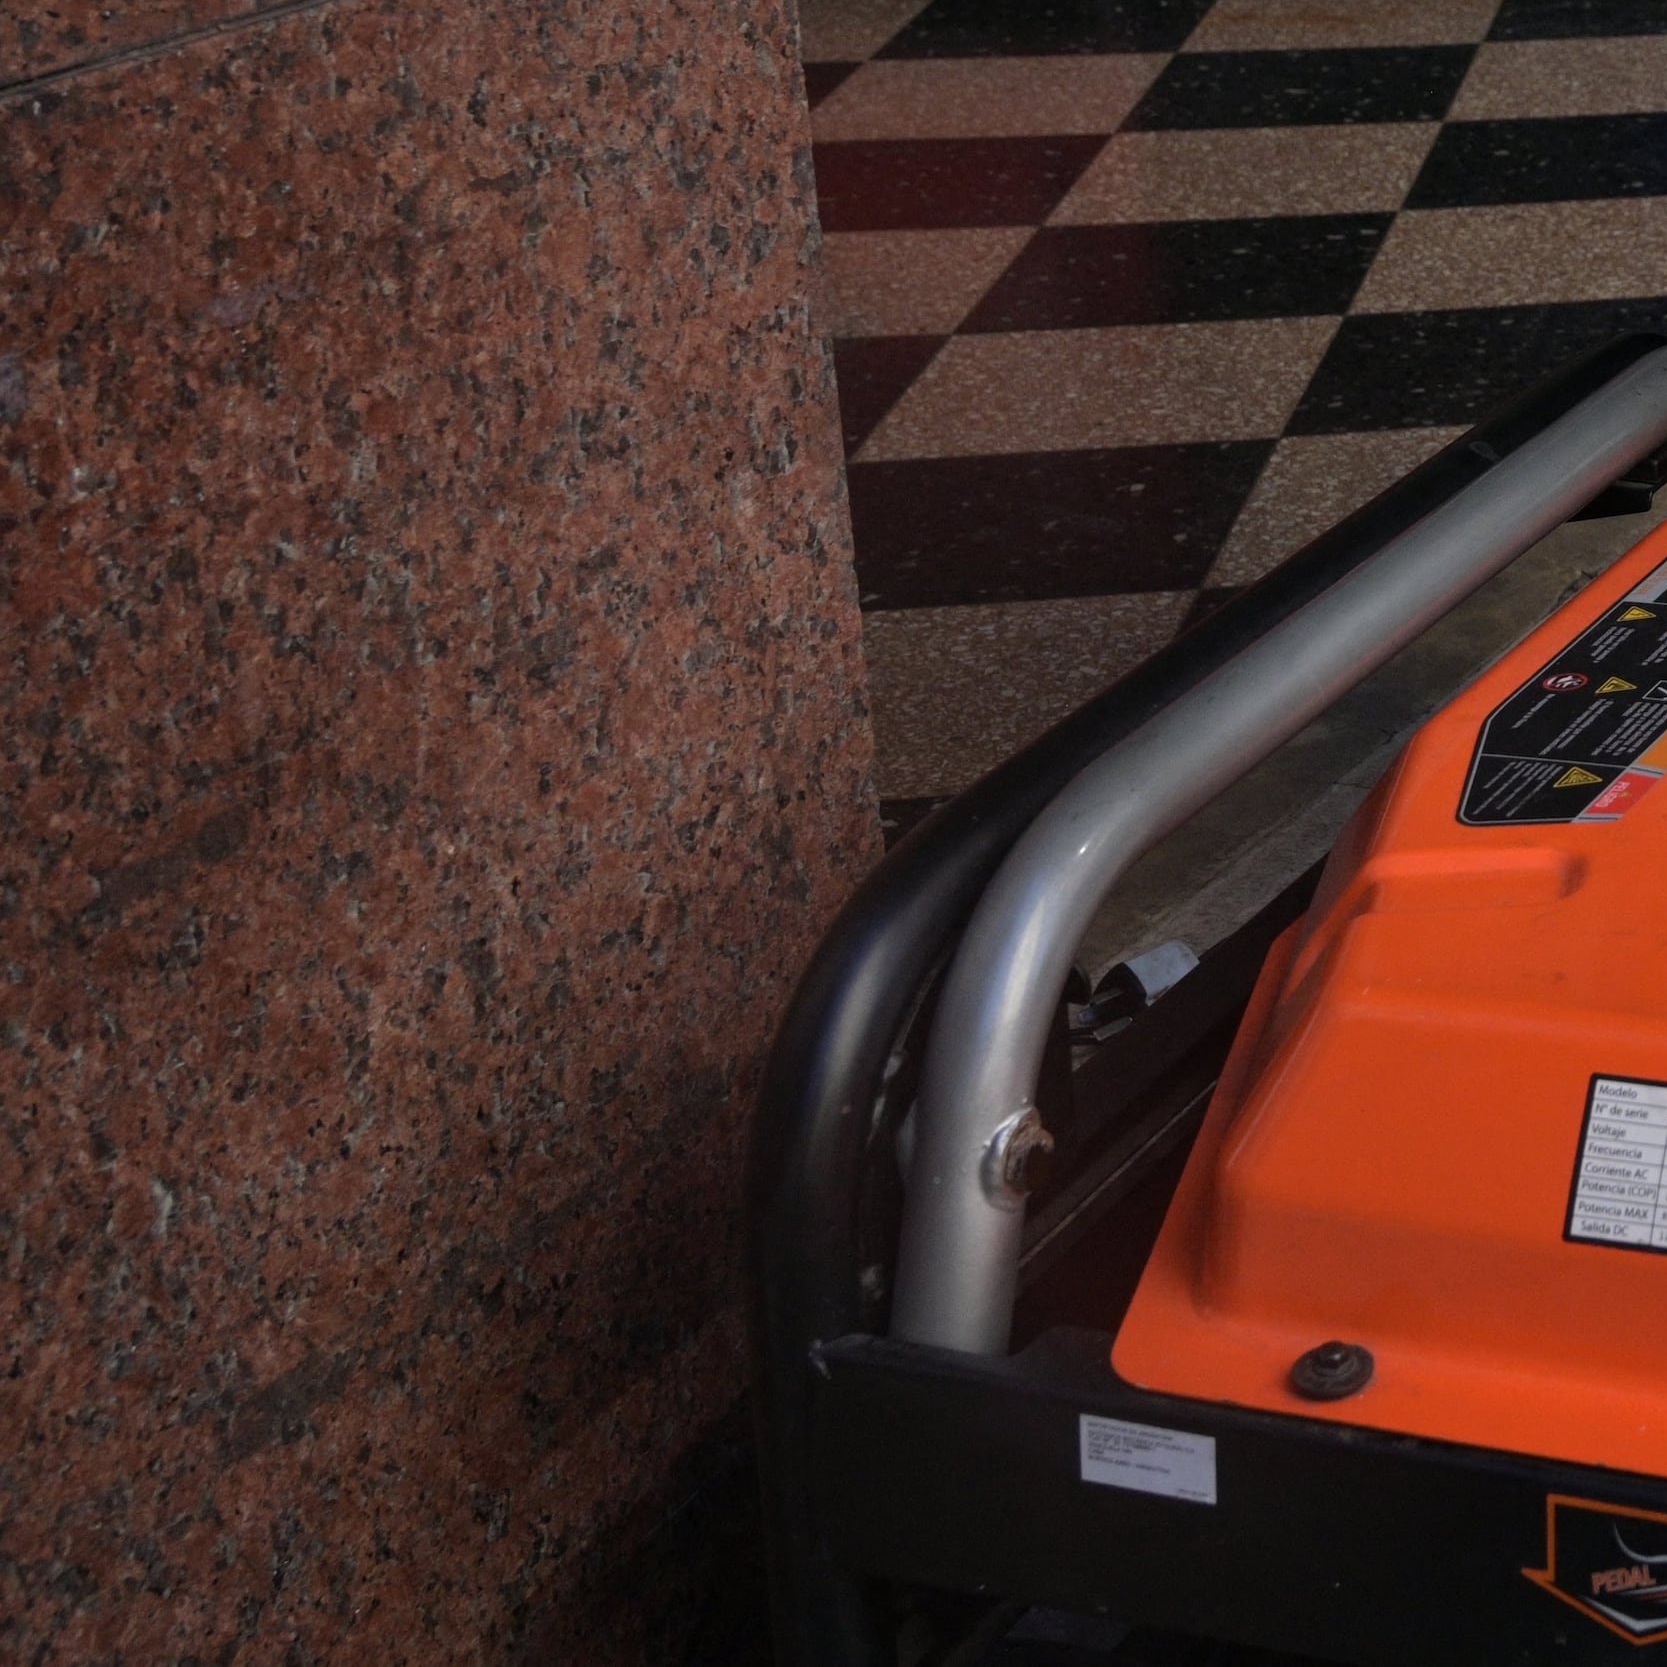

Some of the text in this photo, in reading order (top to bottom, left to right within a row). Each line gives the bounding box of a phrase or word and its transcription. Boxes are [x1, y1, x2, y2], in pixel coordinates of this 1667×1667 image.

[1599, 1085, 1638, 1099] Modelo
[1609, 1105, 1622, 1117] de
[1624, 1108, 1649, 1120] serie
[1592, 1123, 1627, 1139] Voltaje
[1588, 1143, 1643, 1160] Frecuencia
[1584, 1162, 1649, 1180] Corriente AC
[1581, 1179, 1625, 1195] Potencia
[1578, 1201, 1649, 1221] Potencia MAX
[1580, 1220, 1629, 1236] Salida DC
[1591, 1565, 1657, 1594] PEDAL
